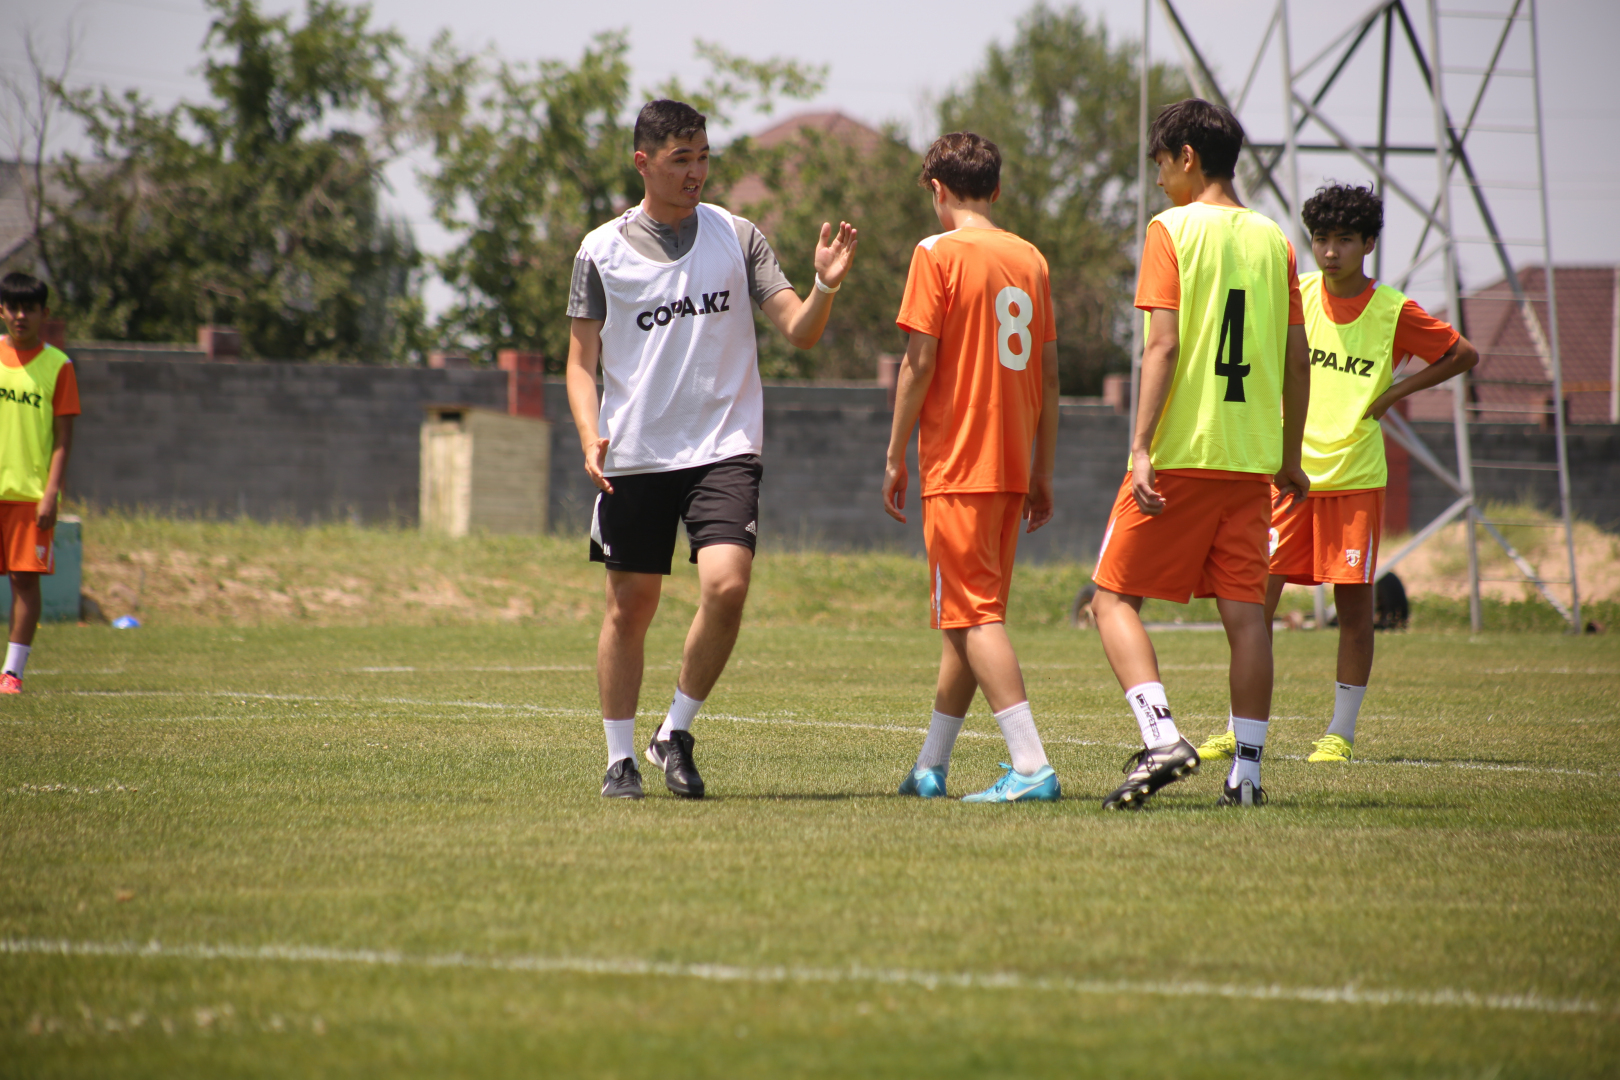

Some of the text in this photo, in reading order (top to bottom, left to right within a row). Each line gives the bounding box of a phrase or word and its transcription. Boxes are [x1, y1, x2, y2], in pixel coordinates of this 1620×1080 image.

[636, 290, 730, 331] COPA.KZ
[995, 286, 1033, 371] 8
[1215, 288, 1251, 402] 4
[1308, 348, 1375, 378] PA.KZ
